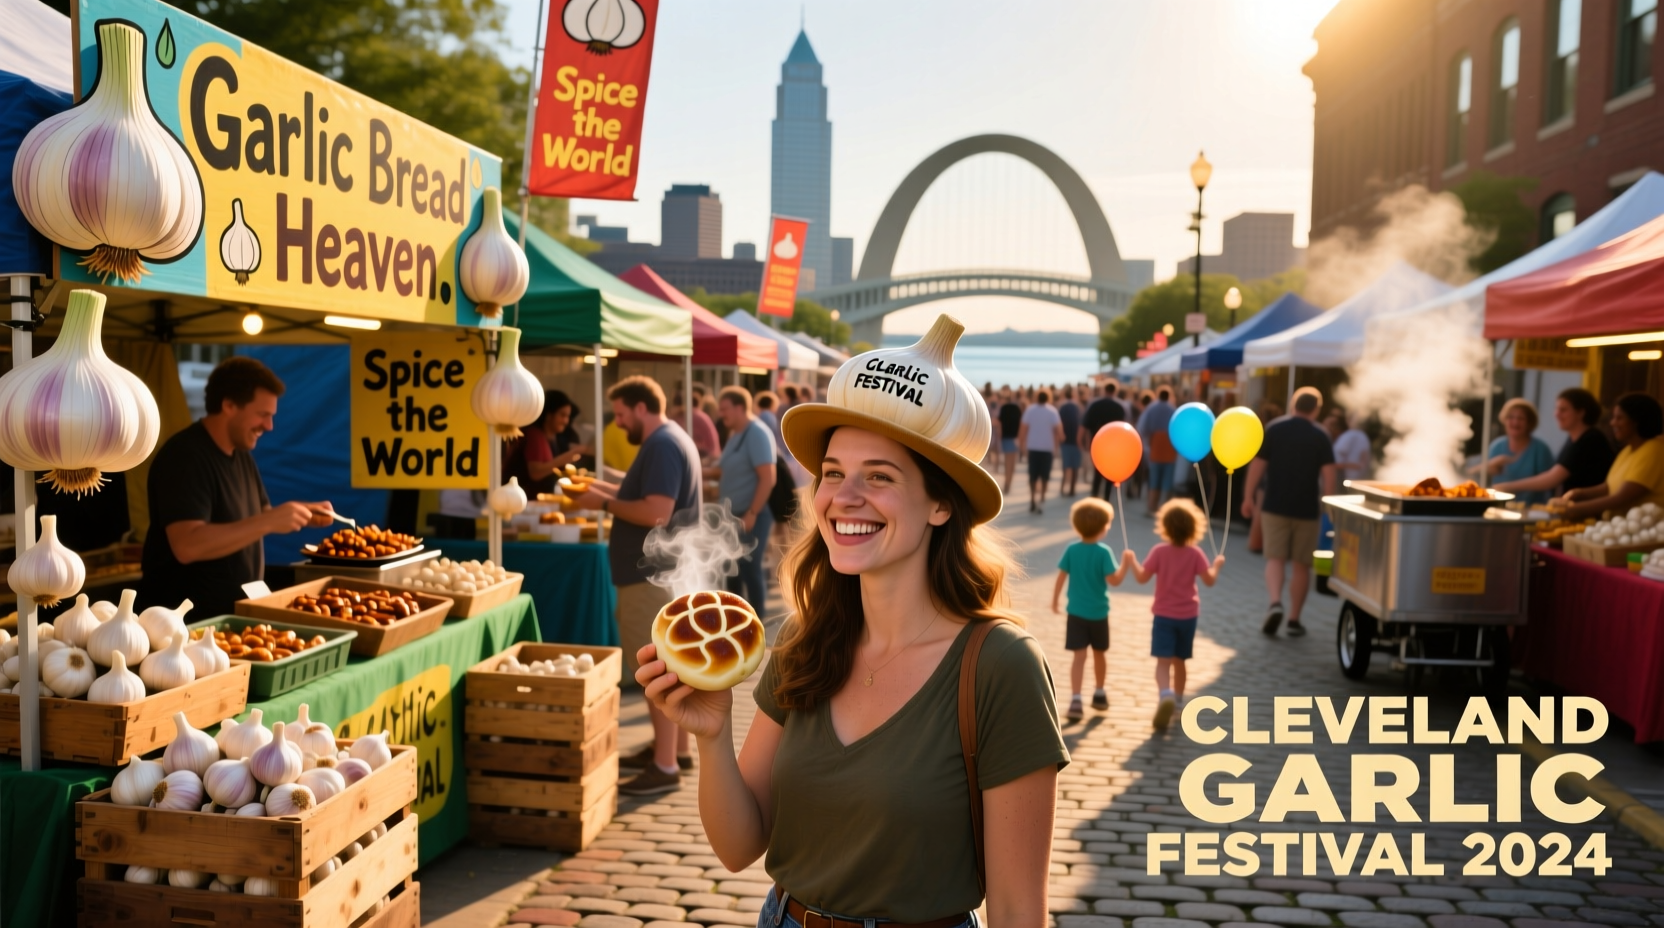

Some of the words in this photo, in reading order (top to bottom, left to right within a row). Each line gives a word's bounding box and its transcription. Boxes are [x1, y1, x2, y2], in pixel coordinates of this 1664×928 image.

[553, 65, 639, 110] Spice
[190, 55, 354, 193] Garlic
[369, 118, 466, 226] Bread
[572, 106, 622, 142] the
[542, 132, 634, 178] World
[276, 192, 451, 305] Heaven.
[363, 348, 465, 399] Spice
[854, 373, 923, 407] FESTIVAL
[386, 395, 448, 432] the
[361, 436, 480, 477] World
